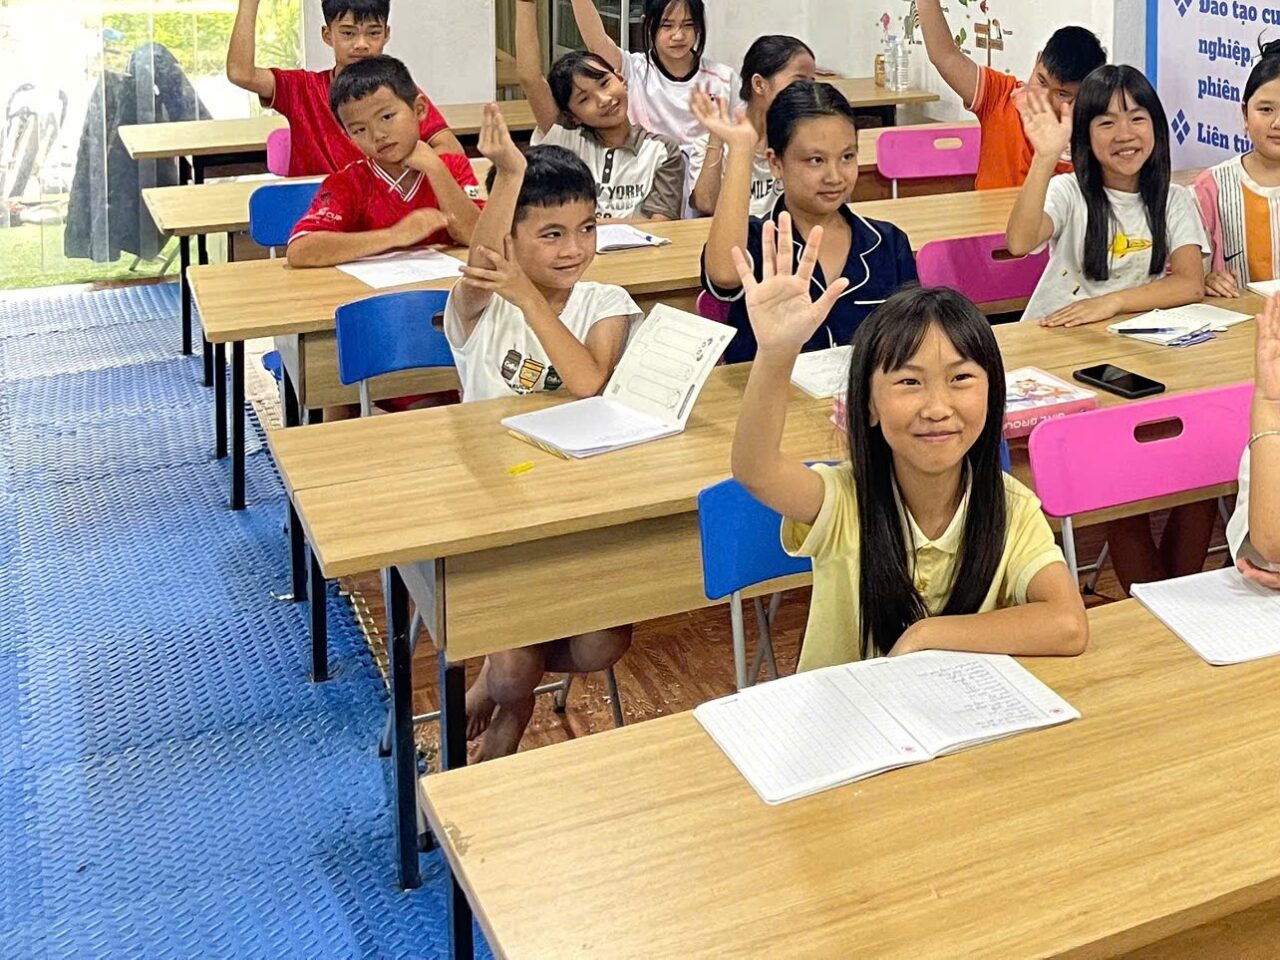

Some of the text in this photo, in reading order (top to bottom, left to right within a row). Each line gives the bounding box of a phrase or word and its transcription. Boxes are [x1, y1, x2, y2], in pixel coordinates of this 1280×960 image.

[1232, 0, 1257, 25] tạo
[1198, 37, 1253, 68] nghiệp,
[1198, 75, 1241, 102] phiên
[1197, 122, 1230, 149] Liên
[608, 183, 645, 201] YORK
[1004, 417, 1038, 430] GROU
